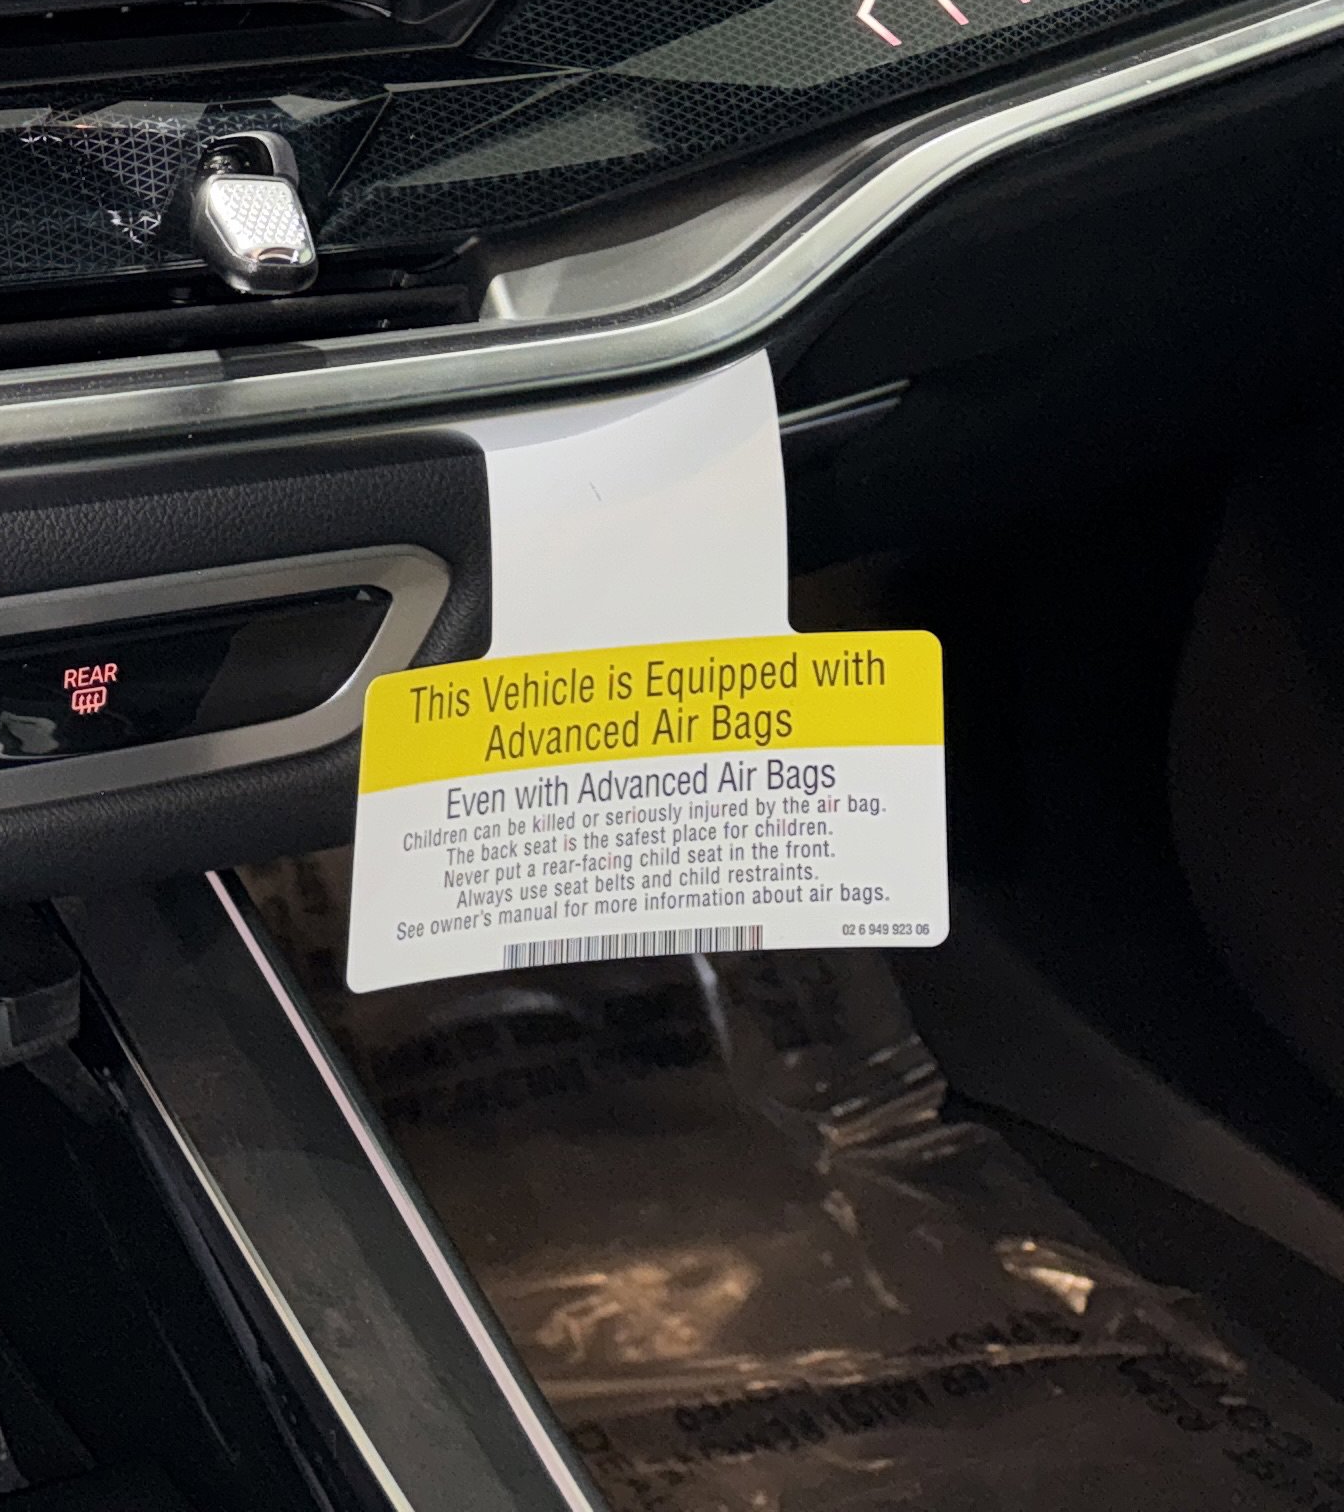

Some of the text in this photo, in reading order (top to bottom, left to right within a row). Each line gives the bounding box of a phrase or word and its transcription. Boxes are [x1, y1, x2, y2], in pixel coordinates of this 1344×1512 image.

[62, 663, 118, 688] REAR
[410, 649, 885, 724] This Vehicle is Equipped with
[484, 704, 793, 762] Advanced Air Bags
[446, 759, 836, 820] Even with Advanced Air Bags
[403, 794, 887, 852] Children can be killed or seriously injured by the air bag.
[446, 818, 833, 866] The back seat is the safest place for children.
[444, 840, 836, 889] Never put a rear-facing child seat in the front.
[456, 862, 819, 909] Always use seat belts and child restraints.
[396, 882, 890, 941] See owner's manual for more information about air bags.
[842, 923, 930, 936] 02 6 949 923 06
